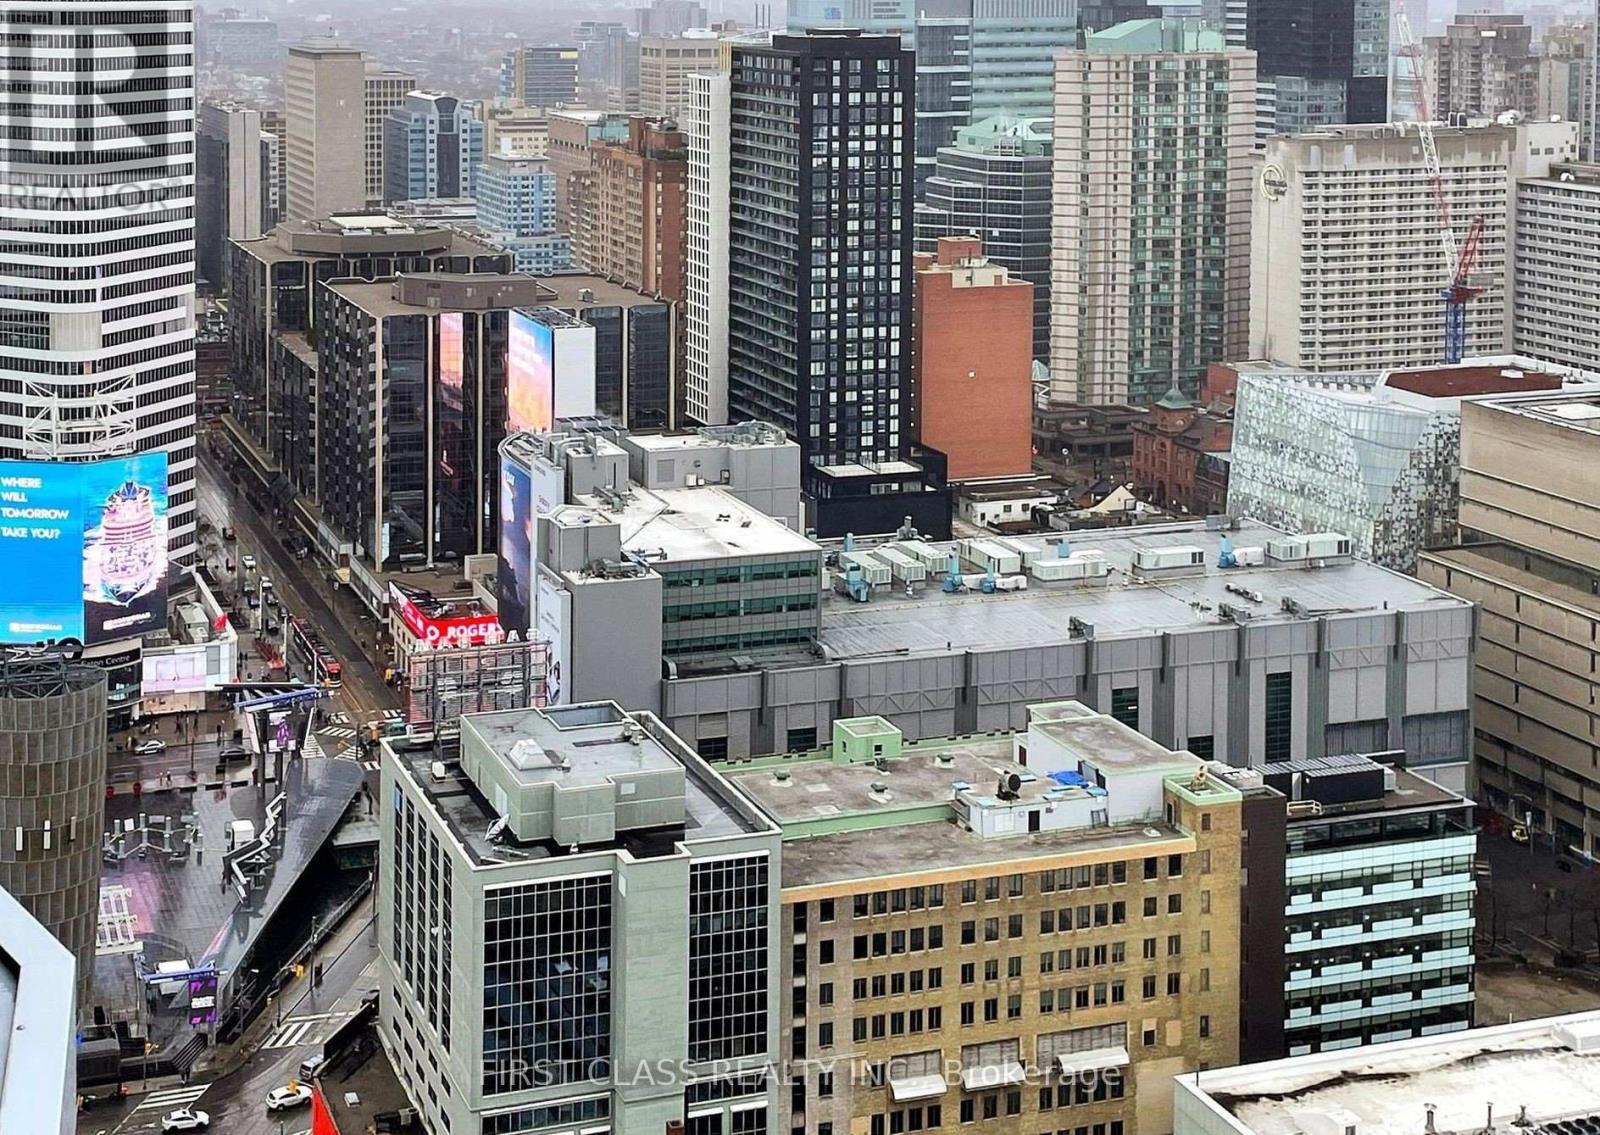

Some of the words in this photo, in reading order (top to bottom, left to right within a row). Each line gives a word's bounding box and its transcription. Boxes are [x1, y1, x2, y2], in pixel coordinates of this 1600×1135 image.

[0, 476, 42, 489] WHERE
[0, 491, 28, 503] WILL
[0, 507, 69, 520] TOMORROW
[1, 526, 28, 538] TAKE
[30, 527, 61, 539] YOU?
[105, 655, 130, 665] Centre
